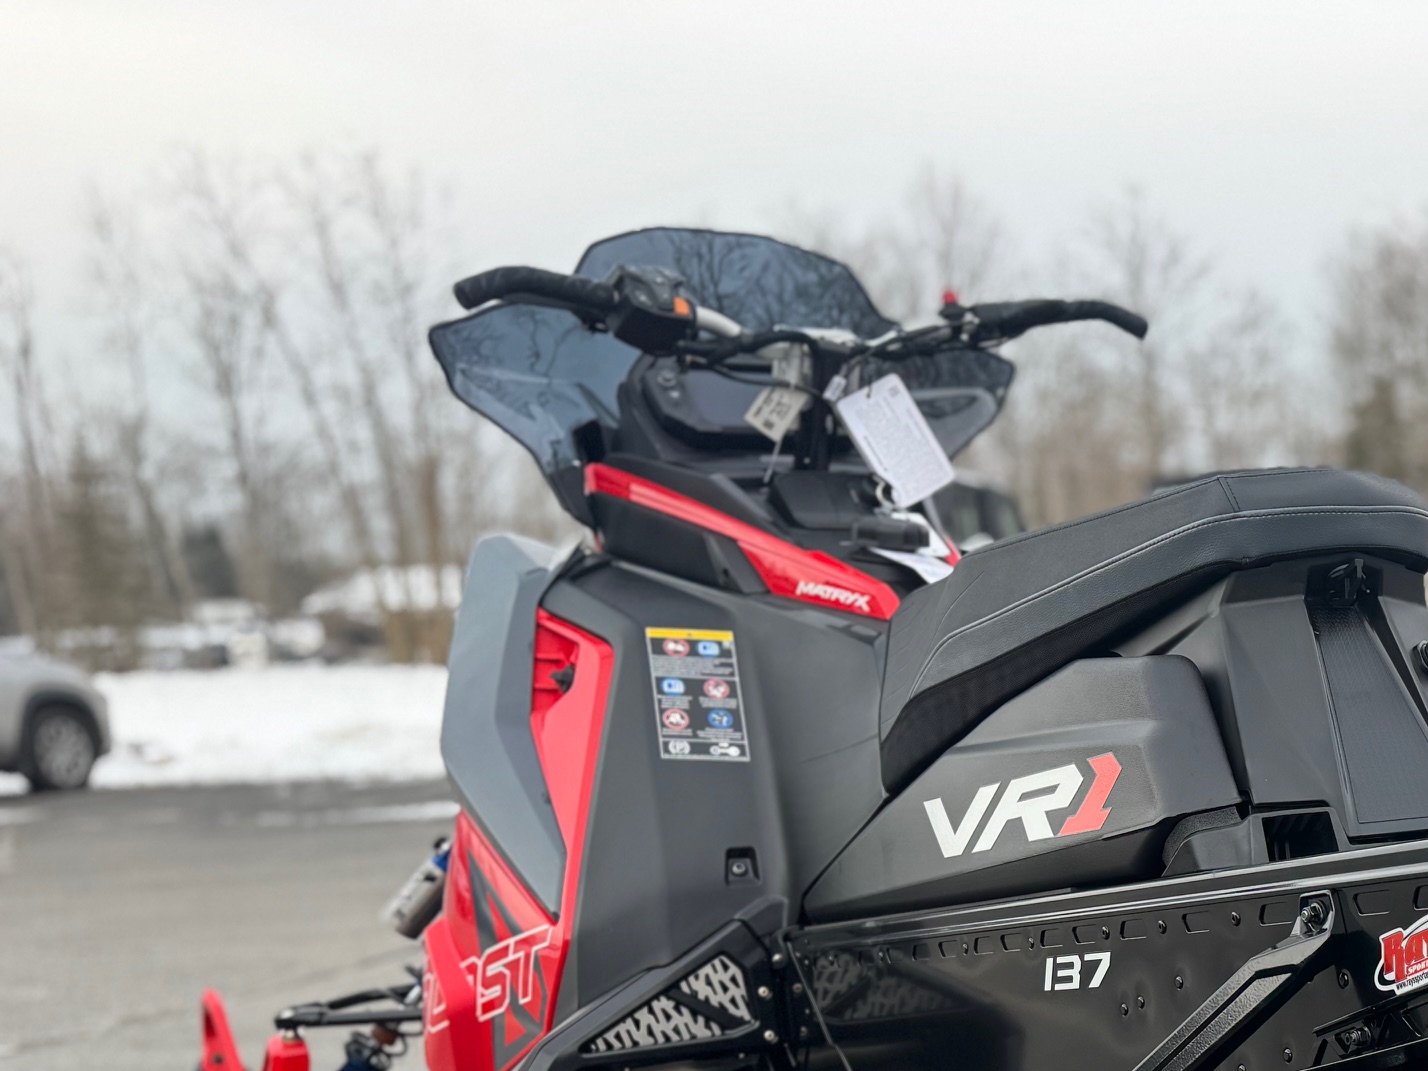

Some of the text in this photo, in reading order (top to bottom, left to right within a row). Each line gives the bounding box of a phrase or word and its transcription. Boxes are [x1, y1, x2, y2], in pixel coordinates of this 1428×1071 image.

[795, 580, 871, 613] MATRYX
[923, 751, 1122, 859] VR1
[1044, 951, 1111, 992] 137
